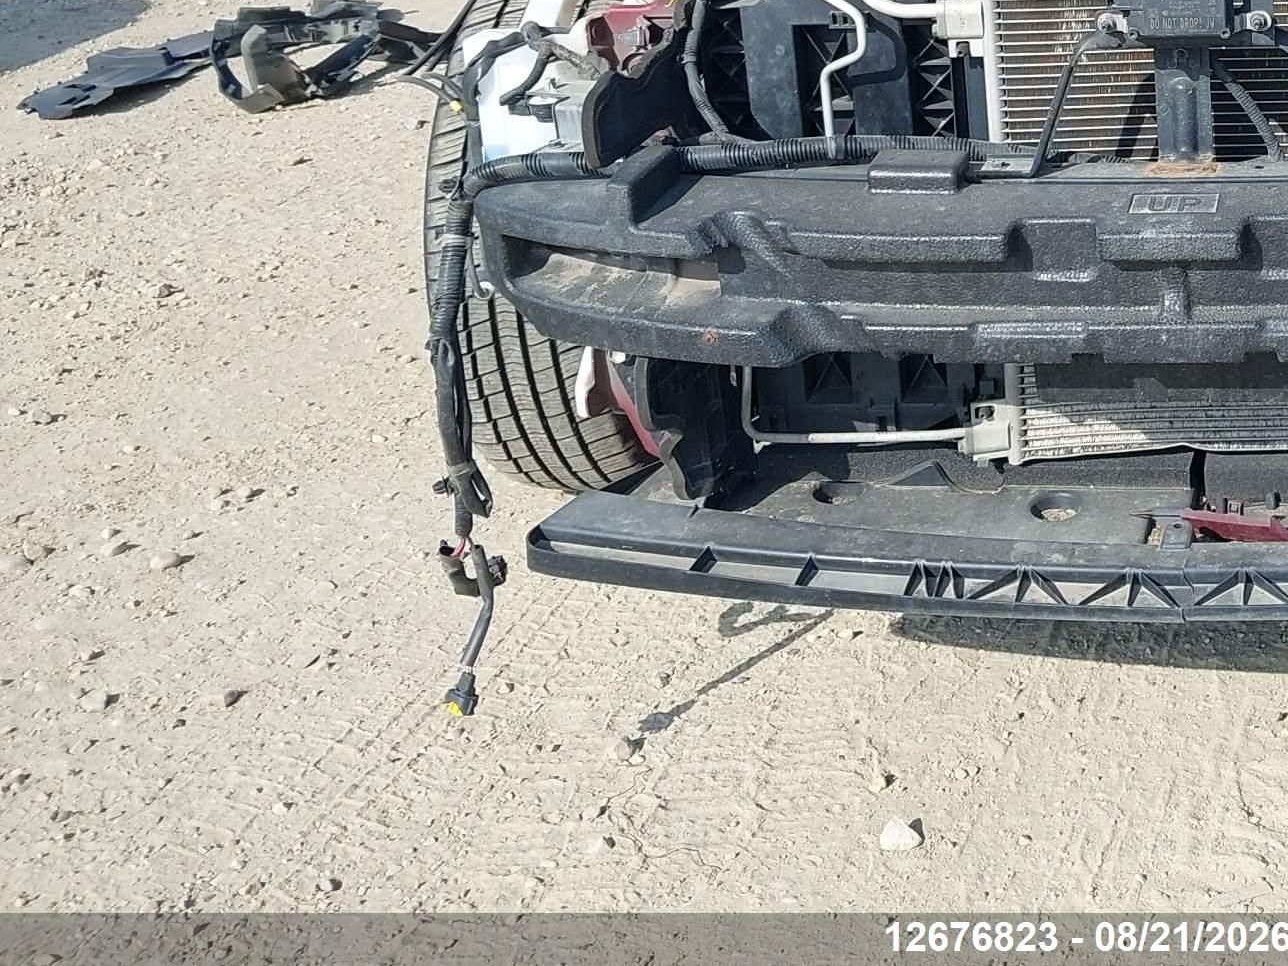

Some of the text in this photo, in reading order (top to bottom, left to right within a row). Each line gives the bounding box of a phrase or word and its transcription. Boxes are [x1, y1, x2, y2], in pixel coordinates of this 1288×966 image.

[1150, 17, 1160, 30] DO
[1162, 17, 1177, 29] NOT
[1179, 17, 1202, 29] DROP!
[1147, 195, 1203, 212] UP
